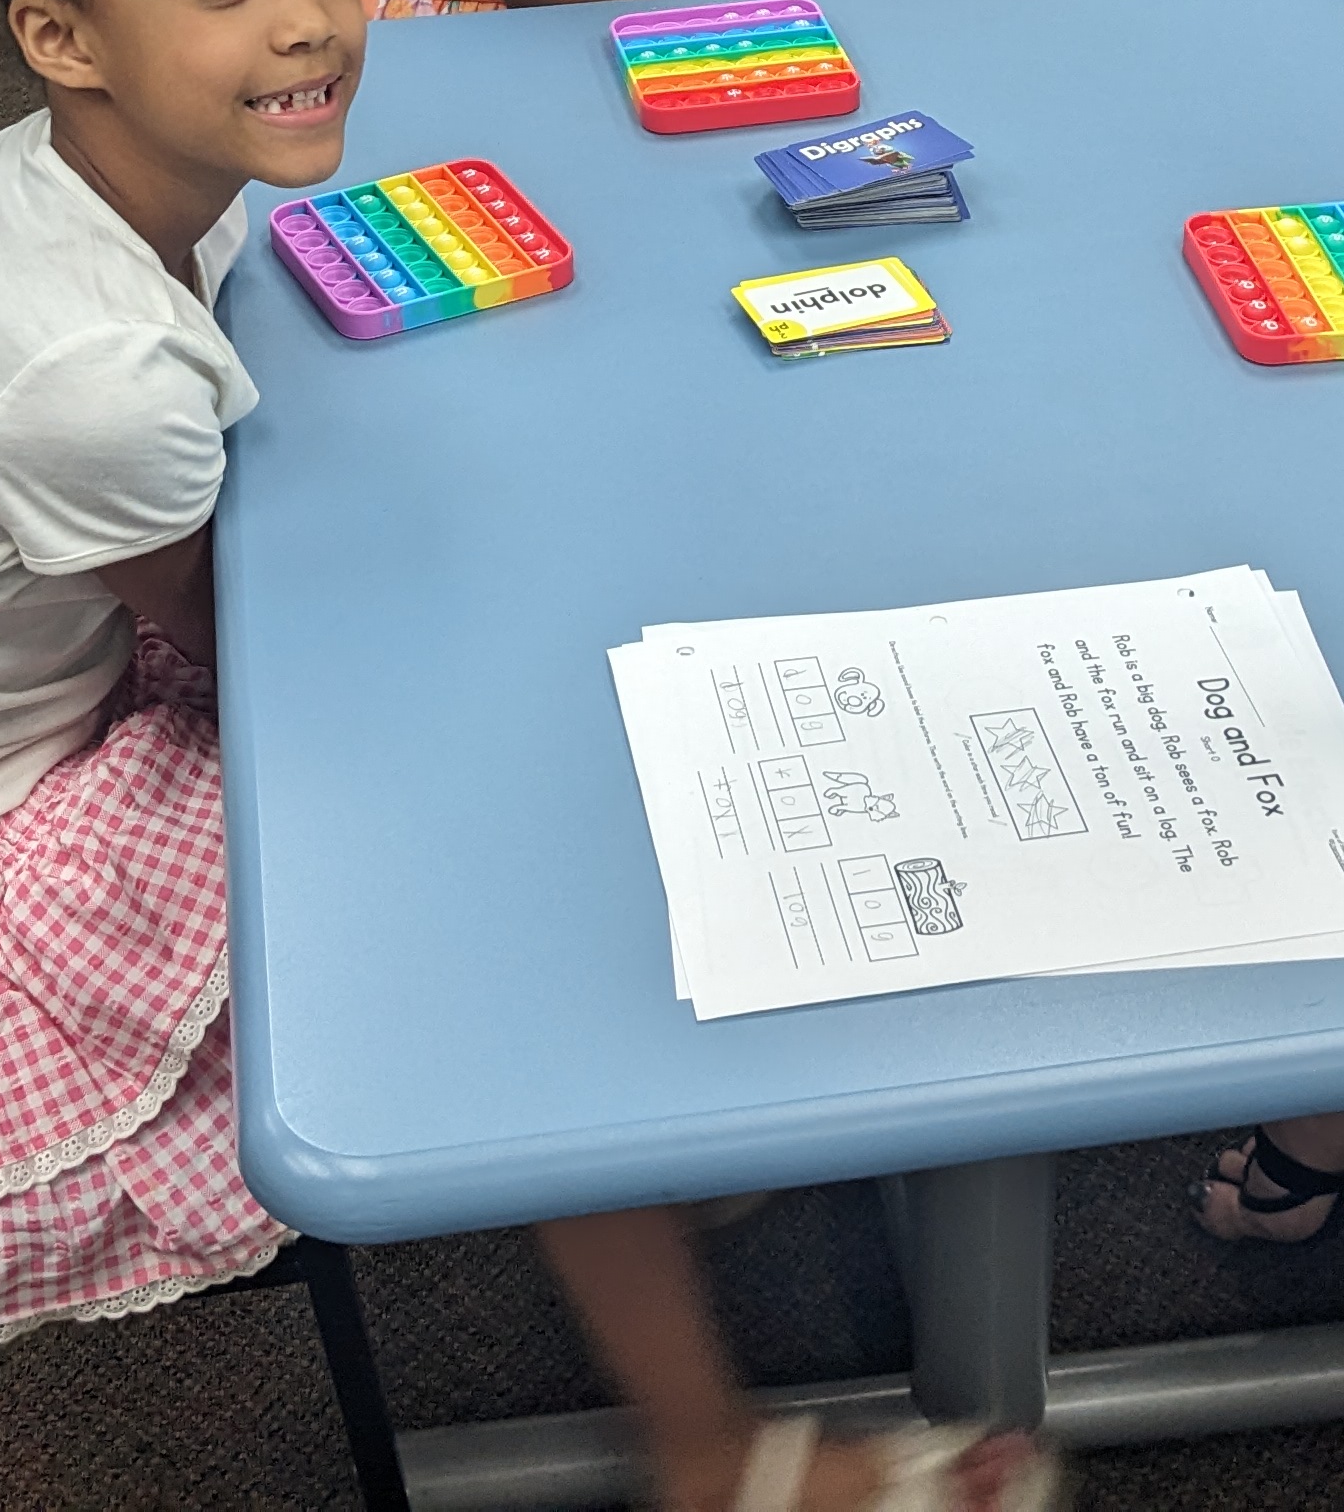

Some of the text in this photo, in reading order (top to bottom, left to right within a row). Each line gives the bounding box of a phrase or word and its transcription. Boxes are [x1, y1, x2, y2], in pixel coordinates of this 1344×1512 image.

[799, 117, 923, 161] Digraphs
[769, 321, 790, 334] ph
[770, 284, 887, 316] dolphin
[1036, 643, 1142, 840] fox and Rob have a ton of fun!
[1074, 639, 1195, 874] and the fox run and sit on a log. The
[1112, 634, 1239, 867] Rob is a big dog. Rob sees a fox. Rob
[1197, 677, 1285, 818] Dog and Fox
[1200, 735, 1217, 756] Short
